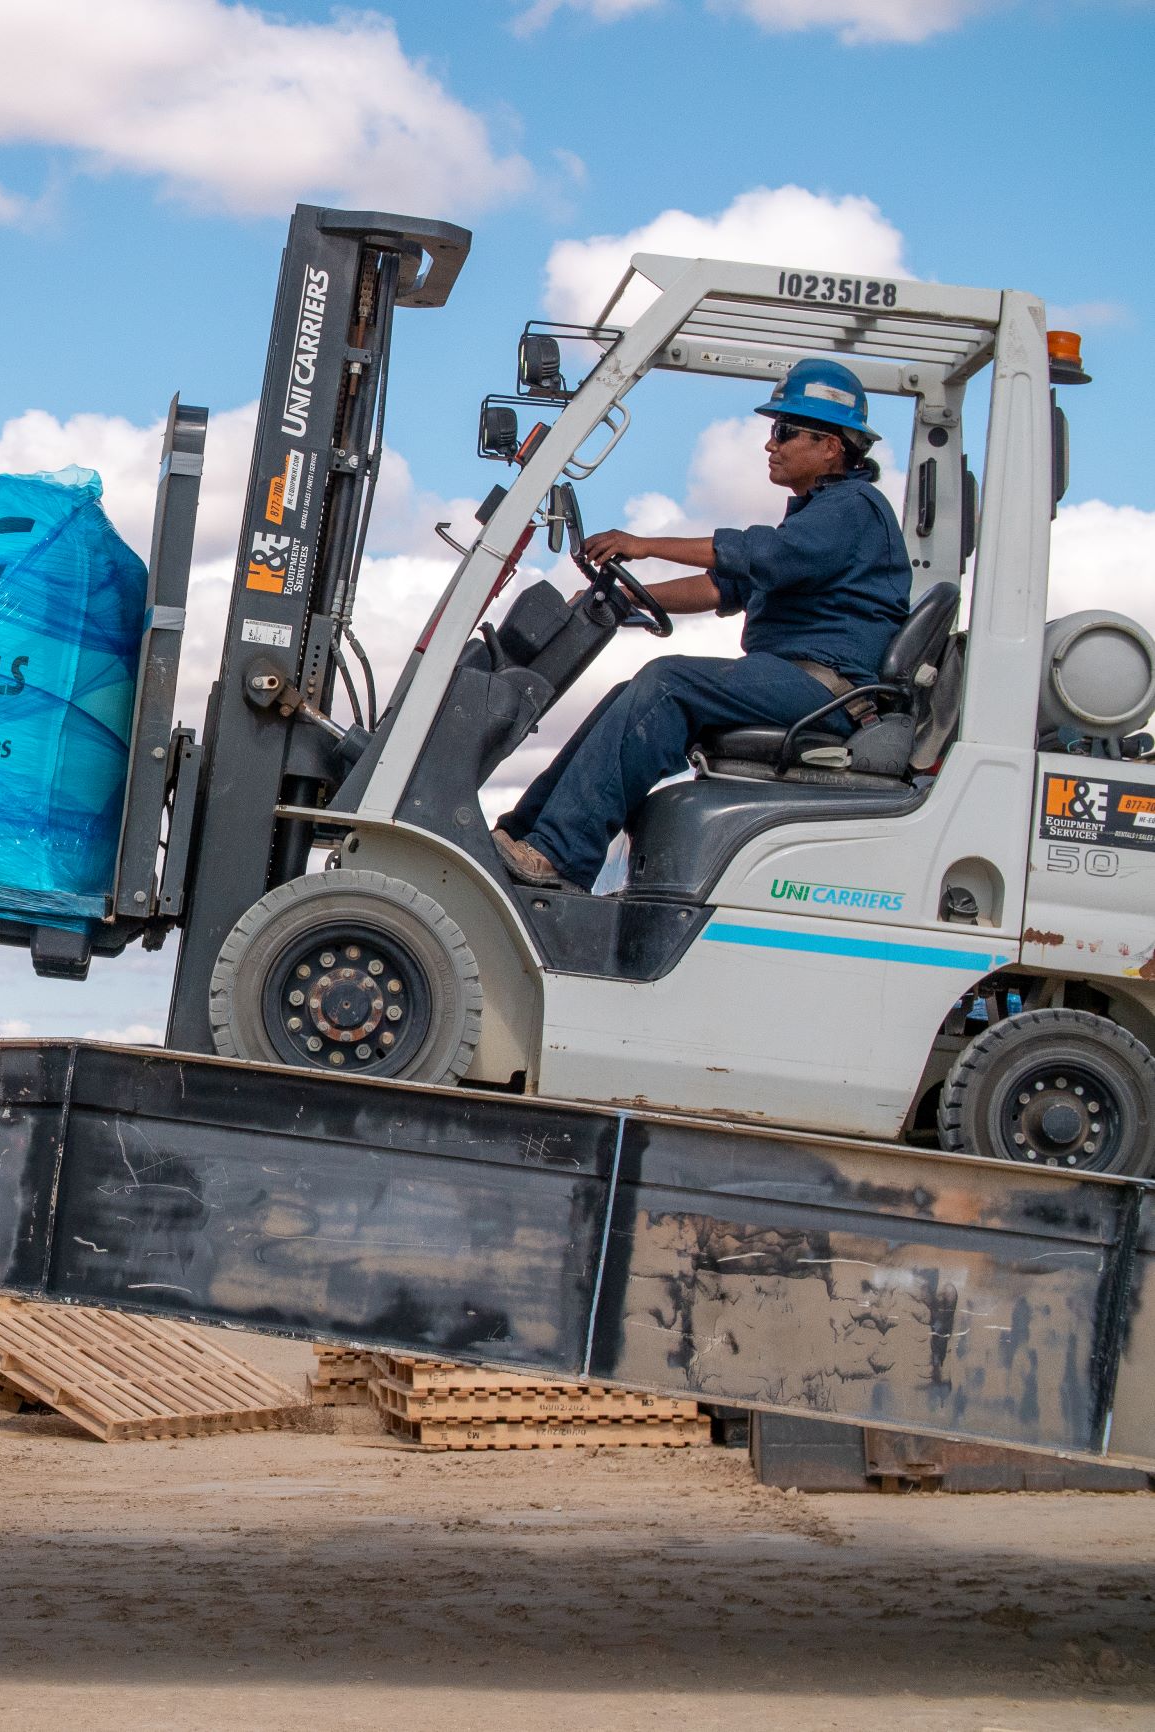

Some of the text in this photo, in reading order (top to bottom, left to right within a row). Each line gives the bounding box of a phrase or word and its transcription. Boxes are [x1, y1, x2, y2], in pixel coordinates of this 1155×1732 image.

[779, 272, 897, 307] 10235128
[284, 537, 301, 595] EQUIPMENT
[294, 545, 309, 593] SERVICES
[1046, 777, 1109, 821] H&E
[1045, 816, 1105, 832] EQUIPMENT
[1049, 825, 1098, 841] SERVICES
[1047, 844, 1119, 878] 50
